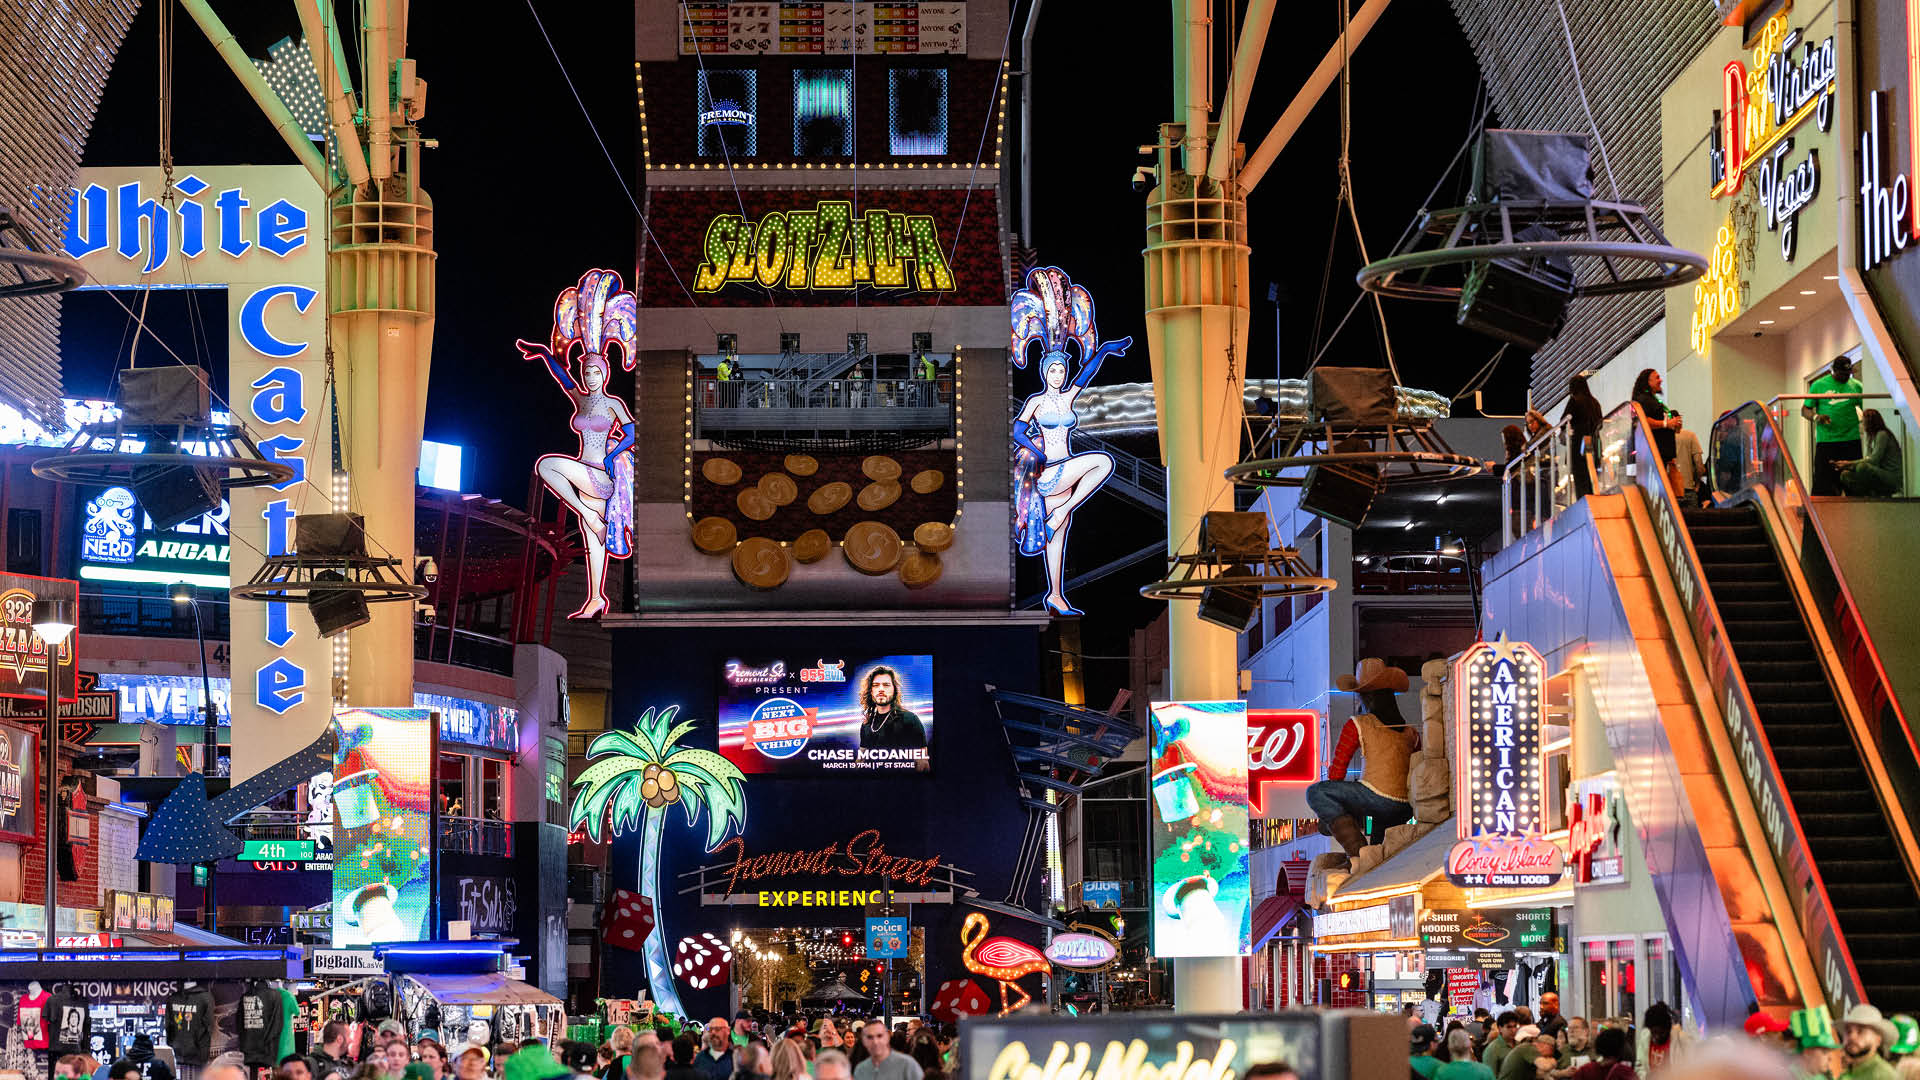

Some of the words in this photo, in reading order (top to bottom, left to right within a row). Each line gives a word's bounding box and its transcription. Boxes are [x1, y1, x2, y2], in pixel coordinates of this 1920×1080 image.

[700, 110, 755, 125] FREMONT
[1724, 60, 1746, 195] D
[1861, 90, 1907, 272] the
[1760, 138, 1820, 262] Vegas
[693, 201, 956, 292] SLOTZILLA
[238, 284, 320, 715] Castle
[84, 539, 133, 557] NERD
[1659, 497, 1675, 562] FOR
[1676, 545, 1694, 611] FUN
[726, 662, 769, 679] Fremont
[769, 661, 786, 679] St.
[119, 685, 187, 714] LIVE
[762, 709, 795, 719] NEXT
[753, 719, 809, 738] BIG
[761, 740, 801, 749] THING
[1491, 662, 1517, 832] AMERICAN
[808, 749, 854, 760] CHASE
[857, 748, 930, 760] MCDANIEL
[1728, 687, 1744, 742] UP
[1741, 730, 1762, 796] FOR
[1762, 788, 1786, 857] FUN
[258, 843, 285, 858] 4th
[712, 836, 838, 902] Fremont
[837, 829, 941, 886] Street
[1455, 847, 1499, 885] Coney
[1501, 847, 1552, 873] Island
[1492, 875, 1518, 884] CHILI
[1521, 875, 1550, 884] DOGS
[460, 879, 478, 928] Fat
[1423, 913, 1458, 922] T-SHIRT
[1516, 913, 1551, 921] SHORTS
[871, 924, 902, 932] POLICE
[1421, 925, 1460, 933] HOODIES
[56, 934, 102, 947] ZZA
[1429, 935, 1452, 944] HATS
[1521, 934, 1547, 943] MORE
[1825, 947, 1842, 1005] UP
[52, 981, 112, 997] CSTOM
[133, 981, 178, 996] KINGS
